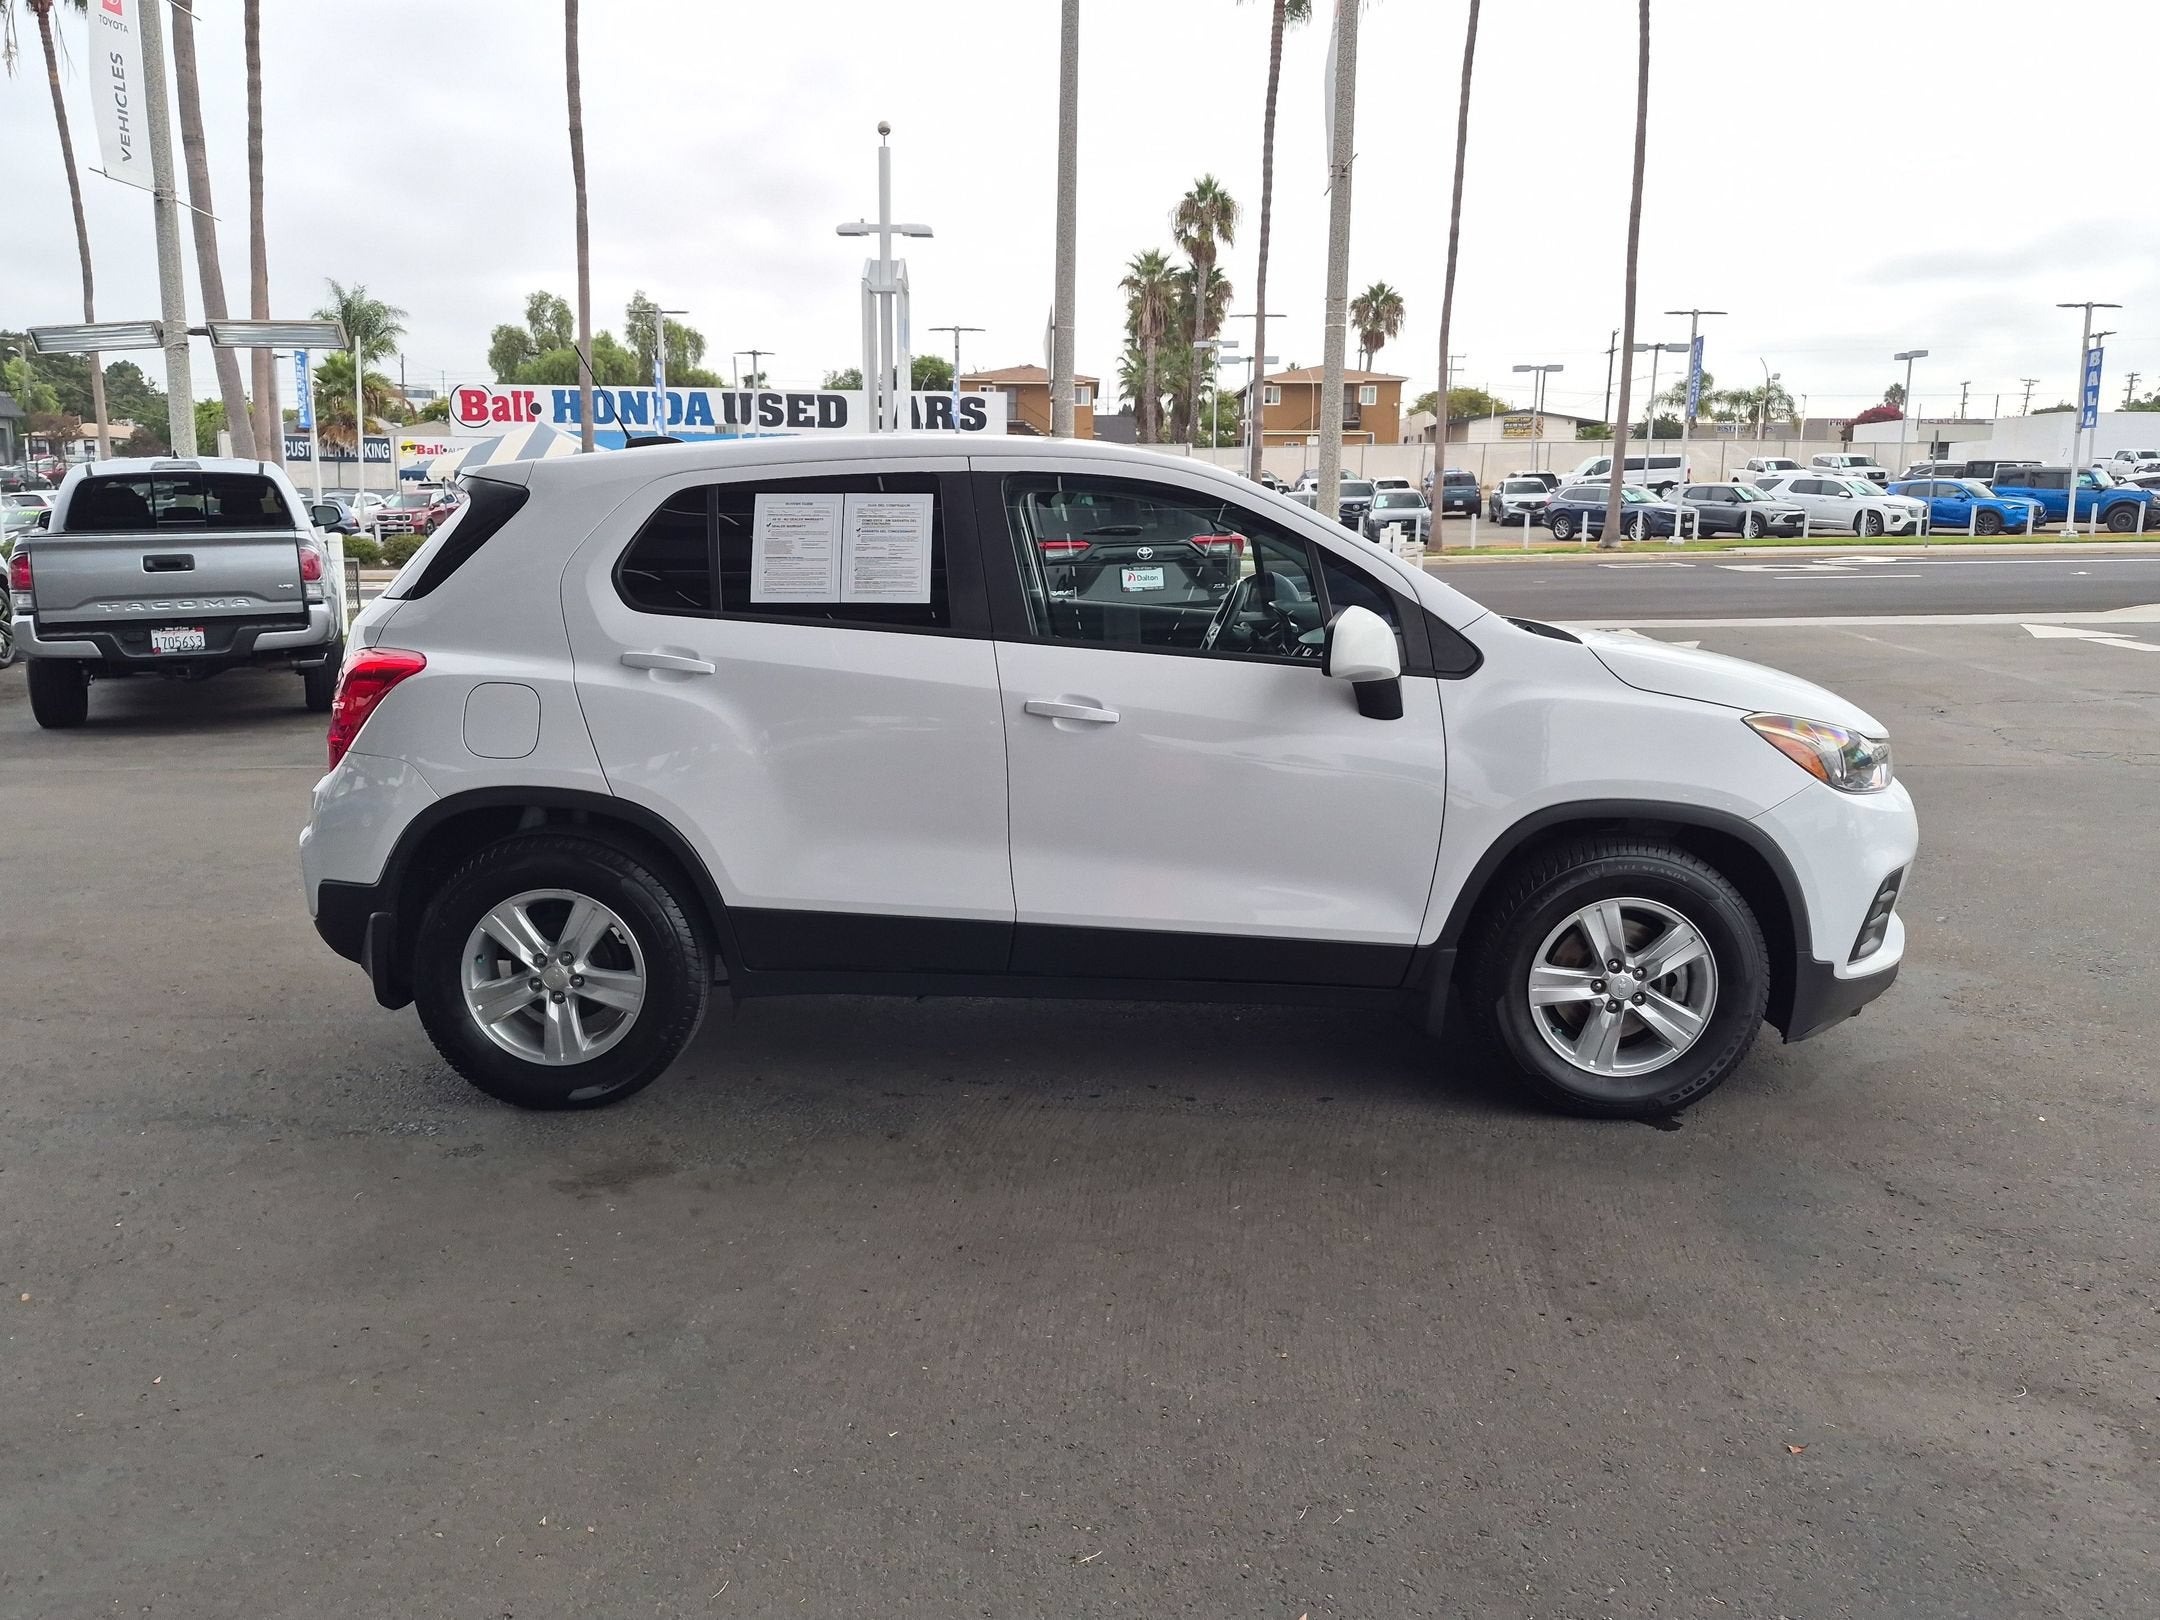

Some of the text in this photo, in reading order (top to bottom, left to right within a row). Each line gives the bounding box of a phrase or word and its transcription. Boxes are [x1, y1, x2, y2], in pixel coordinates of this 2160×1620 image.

[98, 14, 129, 34] TOYOTA
[110, 51, 132, 162] VEHICLES
[2085, 351, 2101, 426] BALL
[551, 389, 716, 427] HONDA
[721, 392, 848, 429] USED
[868, 395, 988, 432] ARS
[1137, 574, 1159, 582] Dalton
[97, 598, 251, 612] TACOMA
